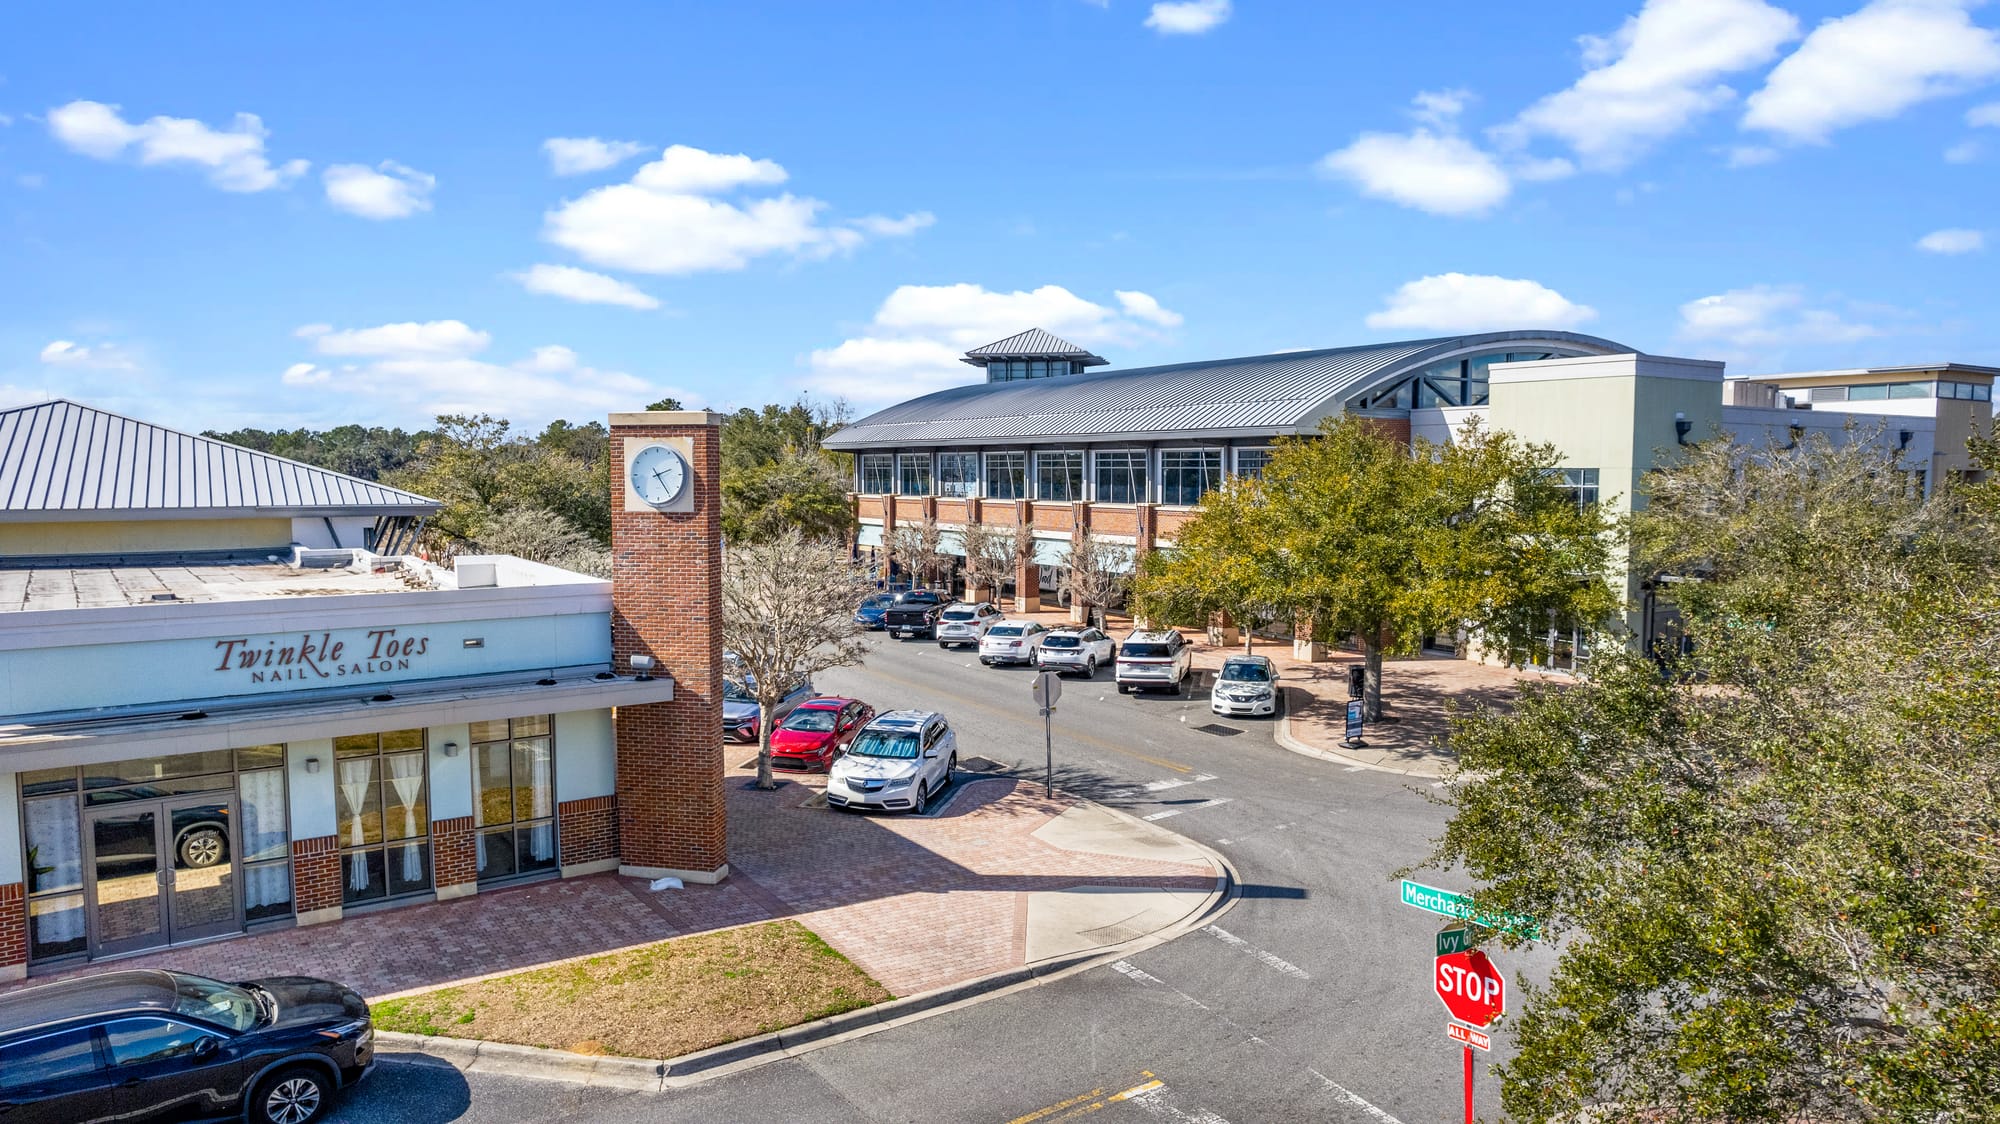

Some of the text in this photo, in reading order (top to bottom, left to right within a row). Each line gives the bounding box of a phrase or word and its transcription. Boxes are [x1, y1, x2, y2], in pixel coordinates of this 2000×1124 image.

[215, 629, 429, 678] Twinkle Toes
[252, 658, 409, 683] NAIL SALON
[1439, 933, 1460, 953] Ivy
[1439, 963, 1500, 1006] STOP
[1449, 1026, 1489, 1047] ALL WAY
